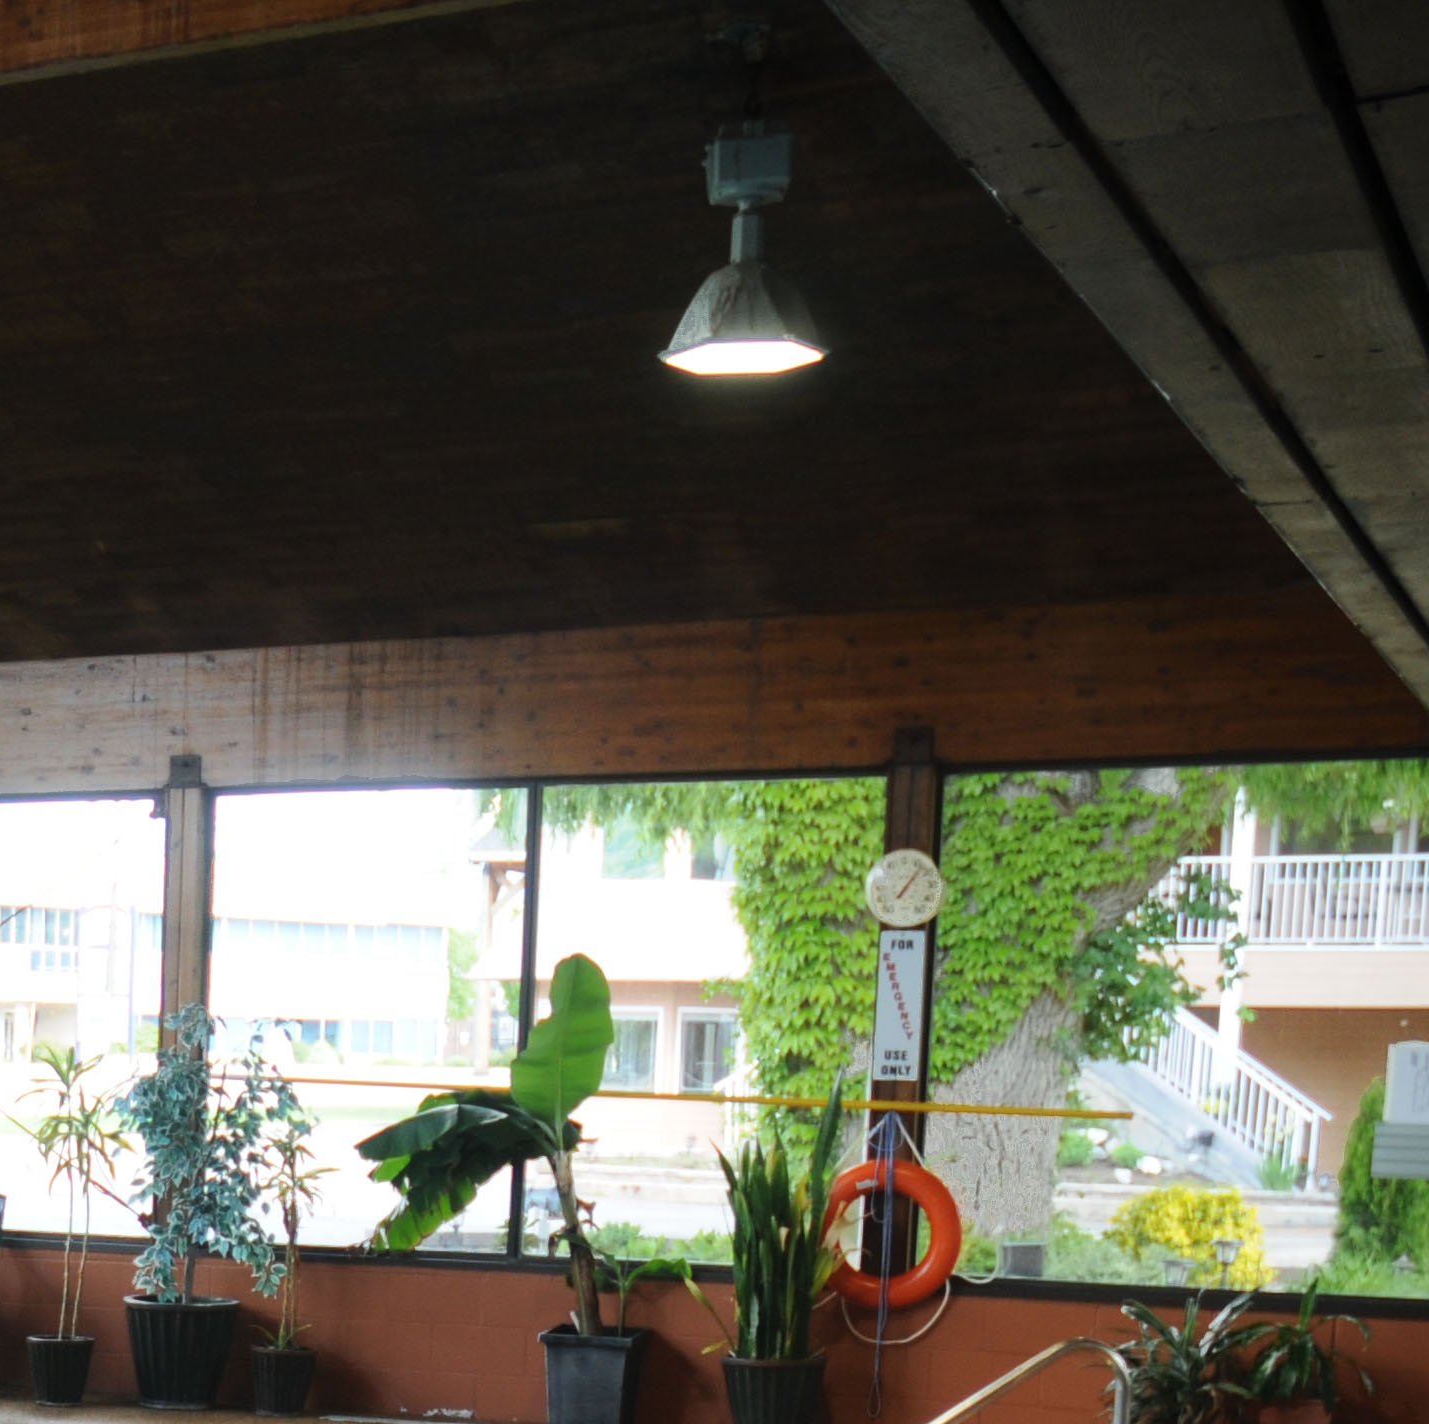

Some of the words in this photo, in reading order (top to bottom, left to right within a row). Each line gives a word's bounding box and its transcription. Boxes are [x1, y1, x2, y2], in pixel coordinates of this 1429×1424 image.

[891, 939, 914, 950] FOR
[883, 952, 914, 1040] EMERGENCY
[884, 1050, 908, 1061] USE
[881, 1065, 911, 1076] ONLY
